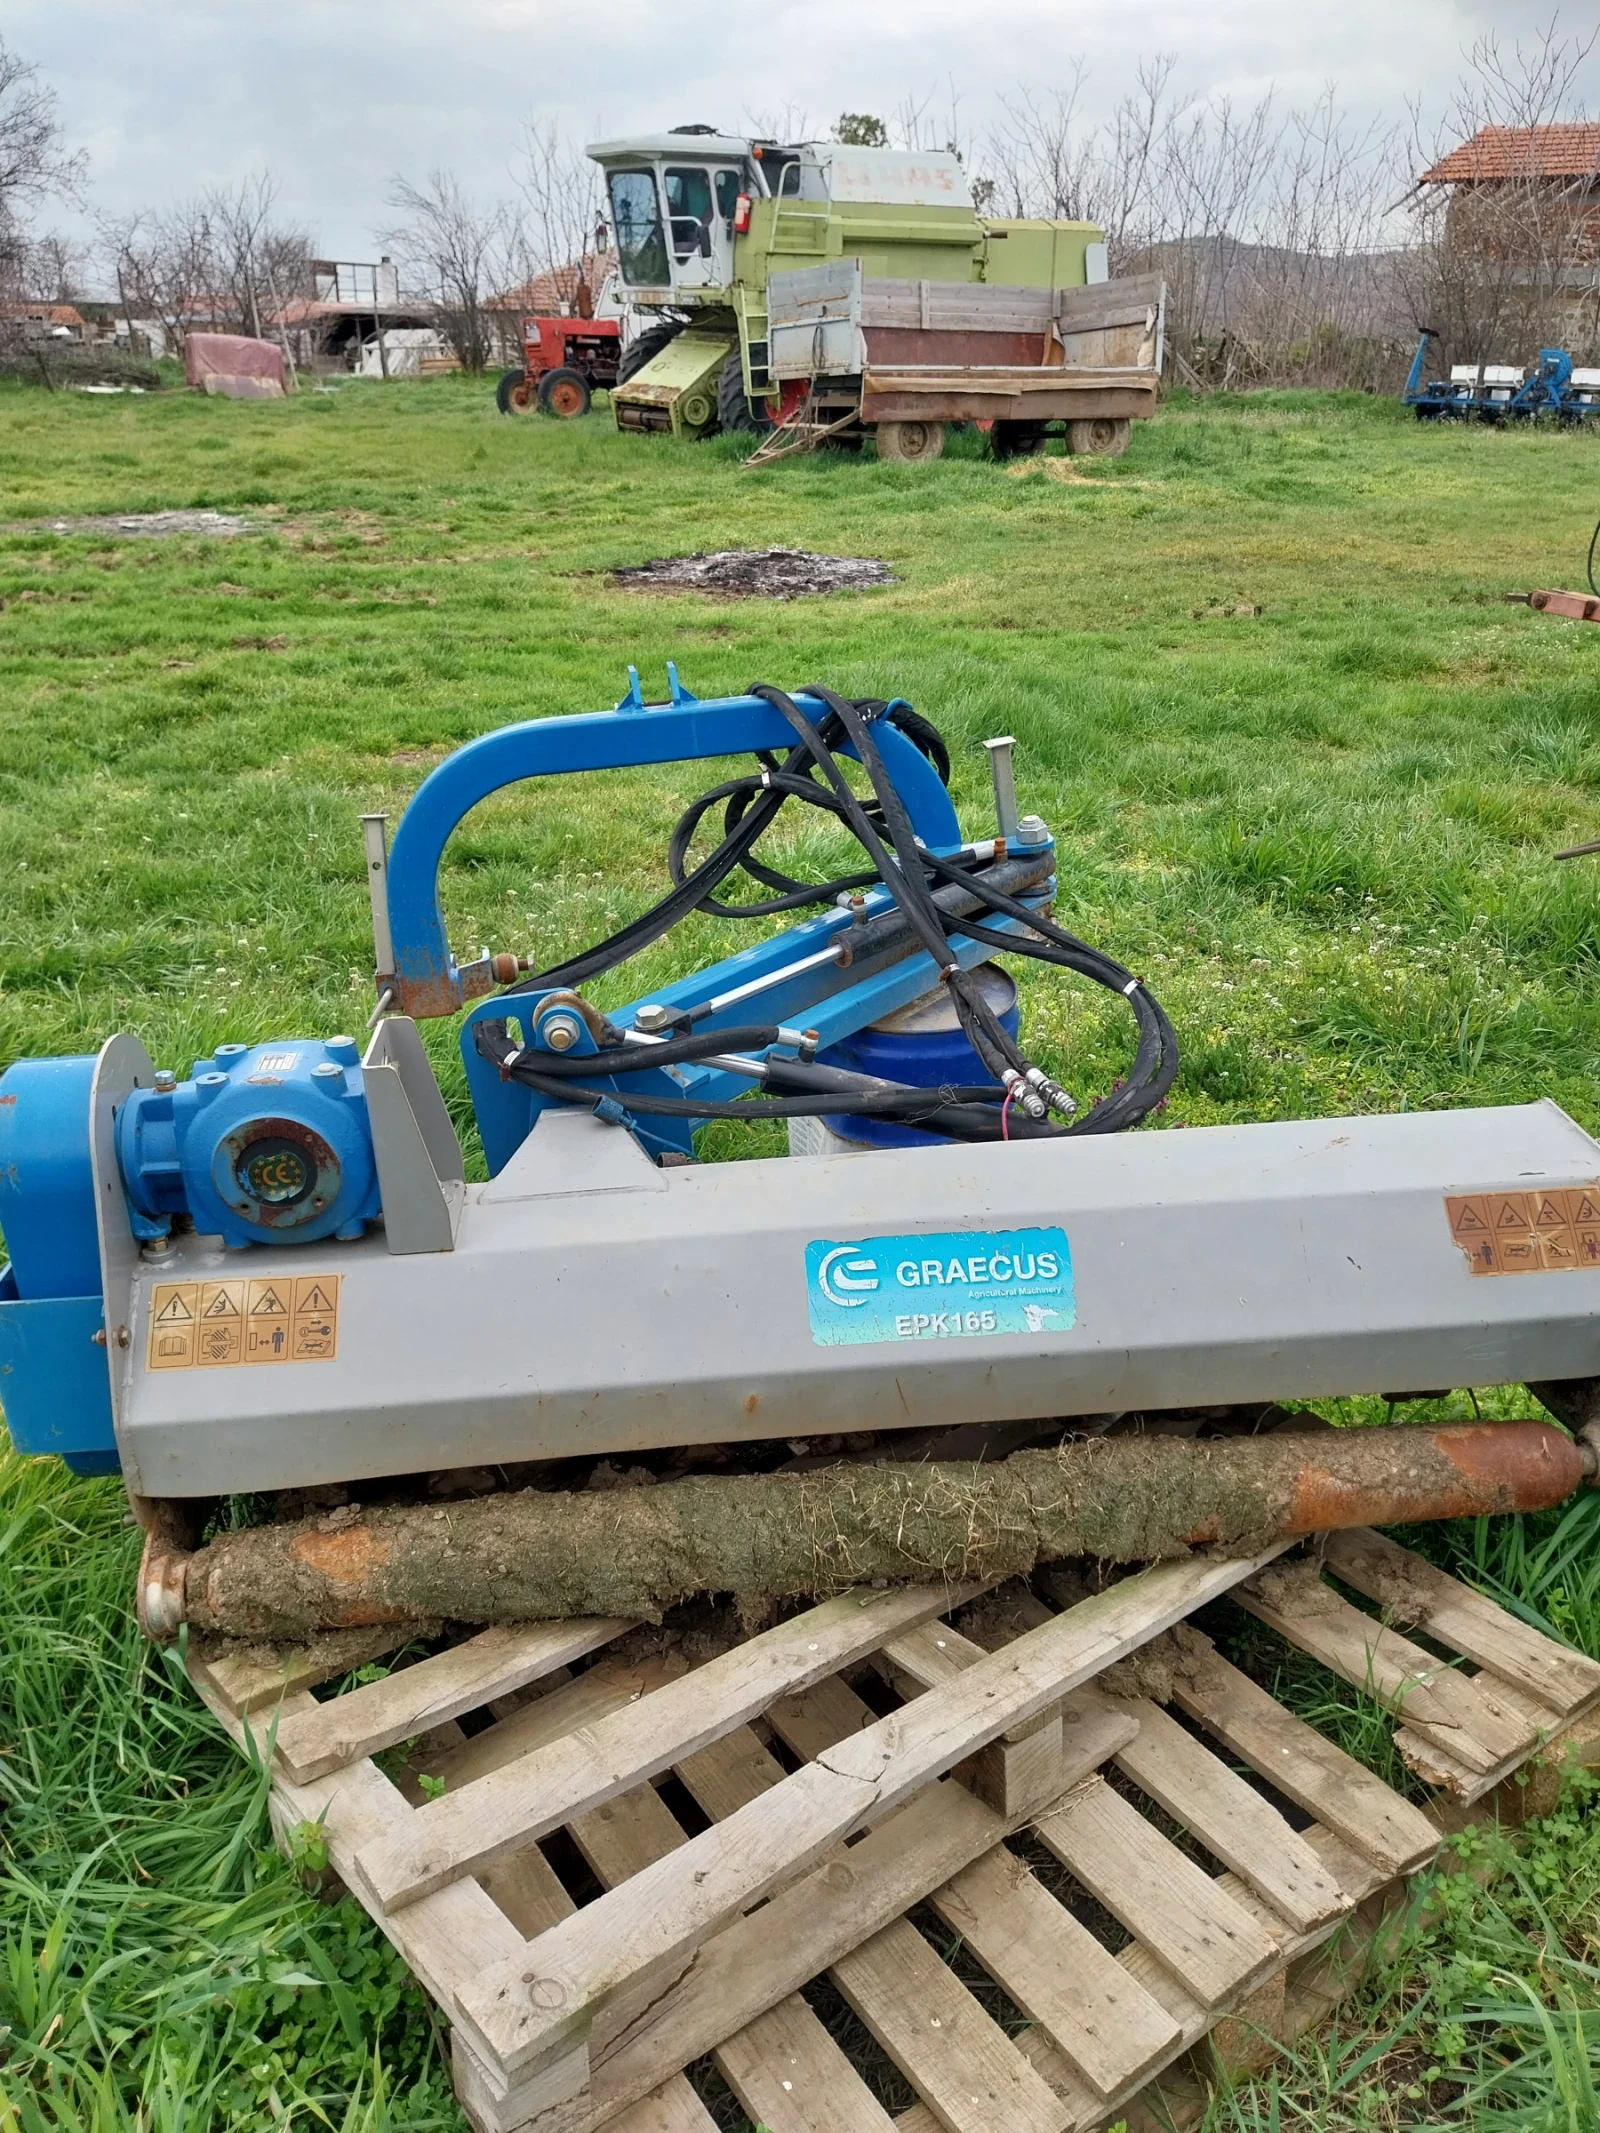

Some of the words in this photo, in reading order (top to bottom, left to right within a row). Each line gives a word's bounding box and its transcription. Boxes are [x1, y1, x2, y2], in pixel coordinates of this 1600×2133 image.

[896, 1252, 1059, 1287] GRAECUS
[968, 1287, 1017, 1299] Agricultural
[1018, 1286, 1062, 1296] Machinery
[894, 1310, 996, 1336] EPK165
